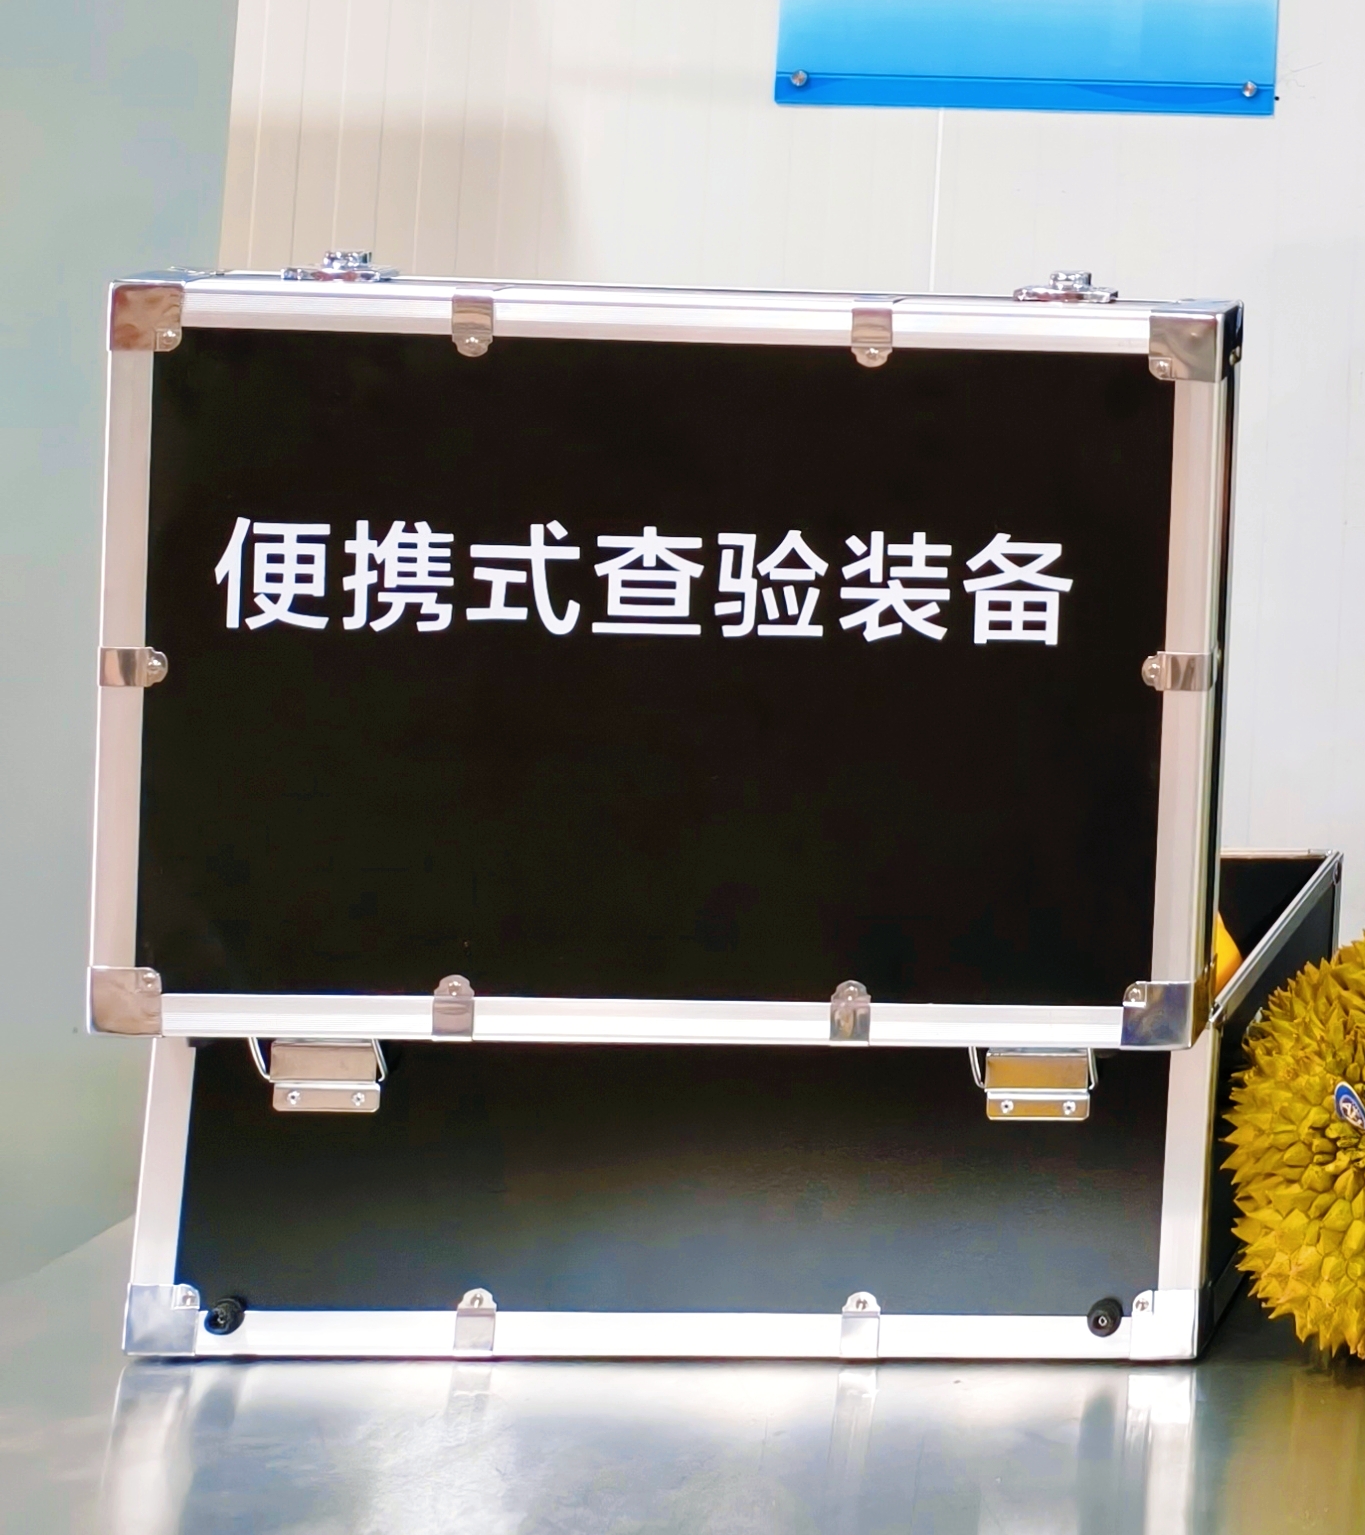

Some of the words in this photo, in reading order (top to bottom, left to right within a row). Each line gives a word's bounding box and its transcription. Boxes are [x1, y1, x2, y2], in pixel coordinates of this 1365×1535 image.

[214, 517, 1074, 646] 便携式查验装备
